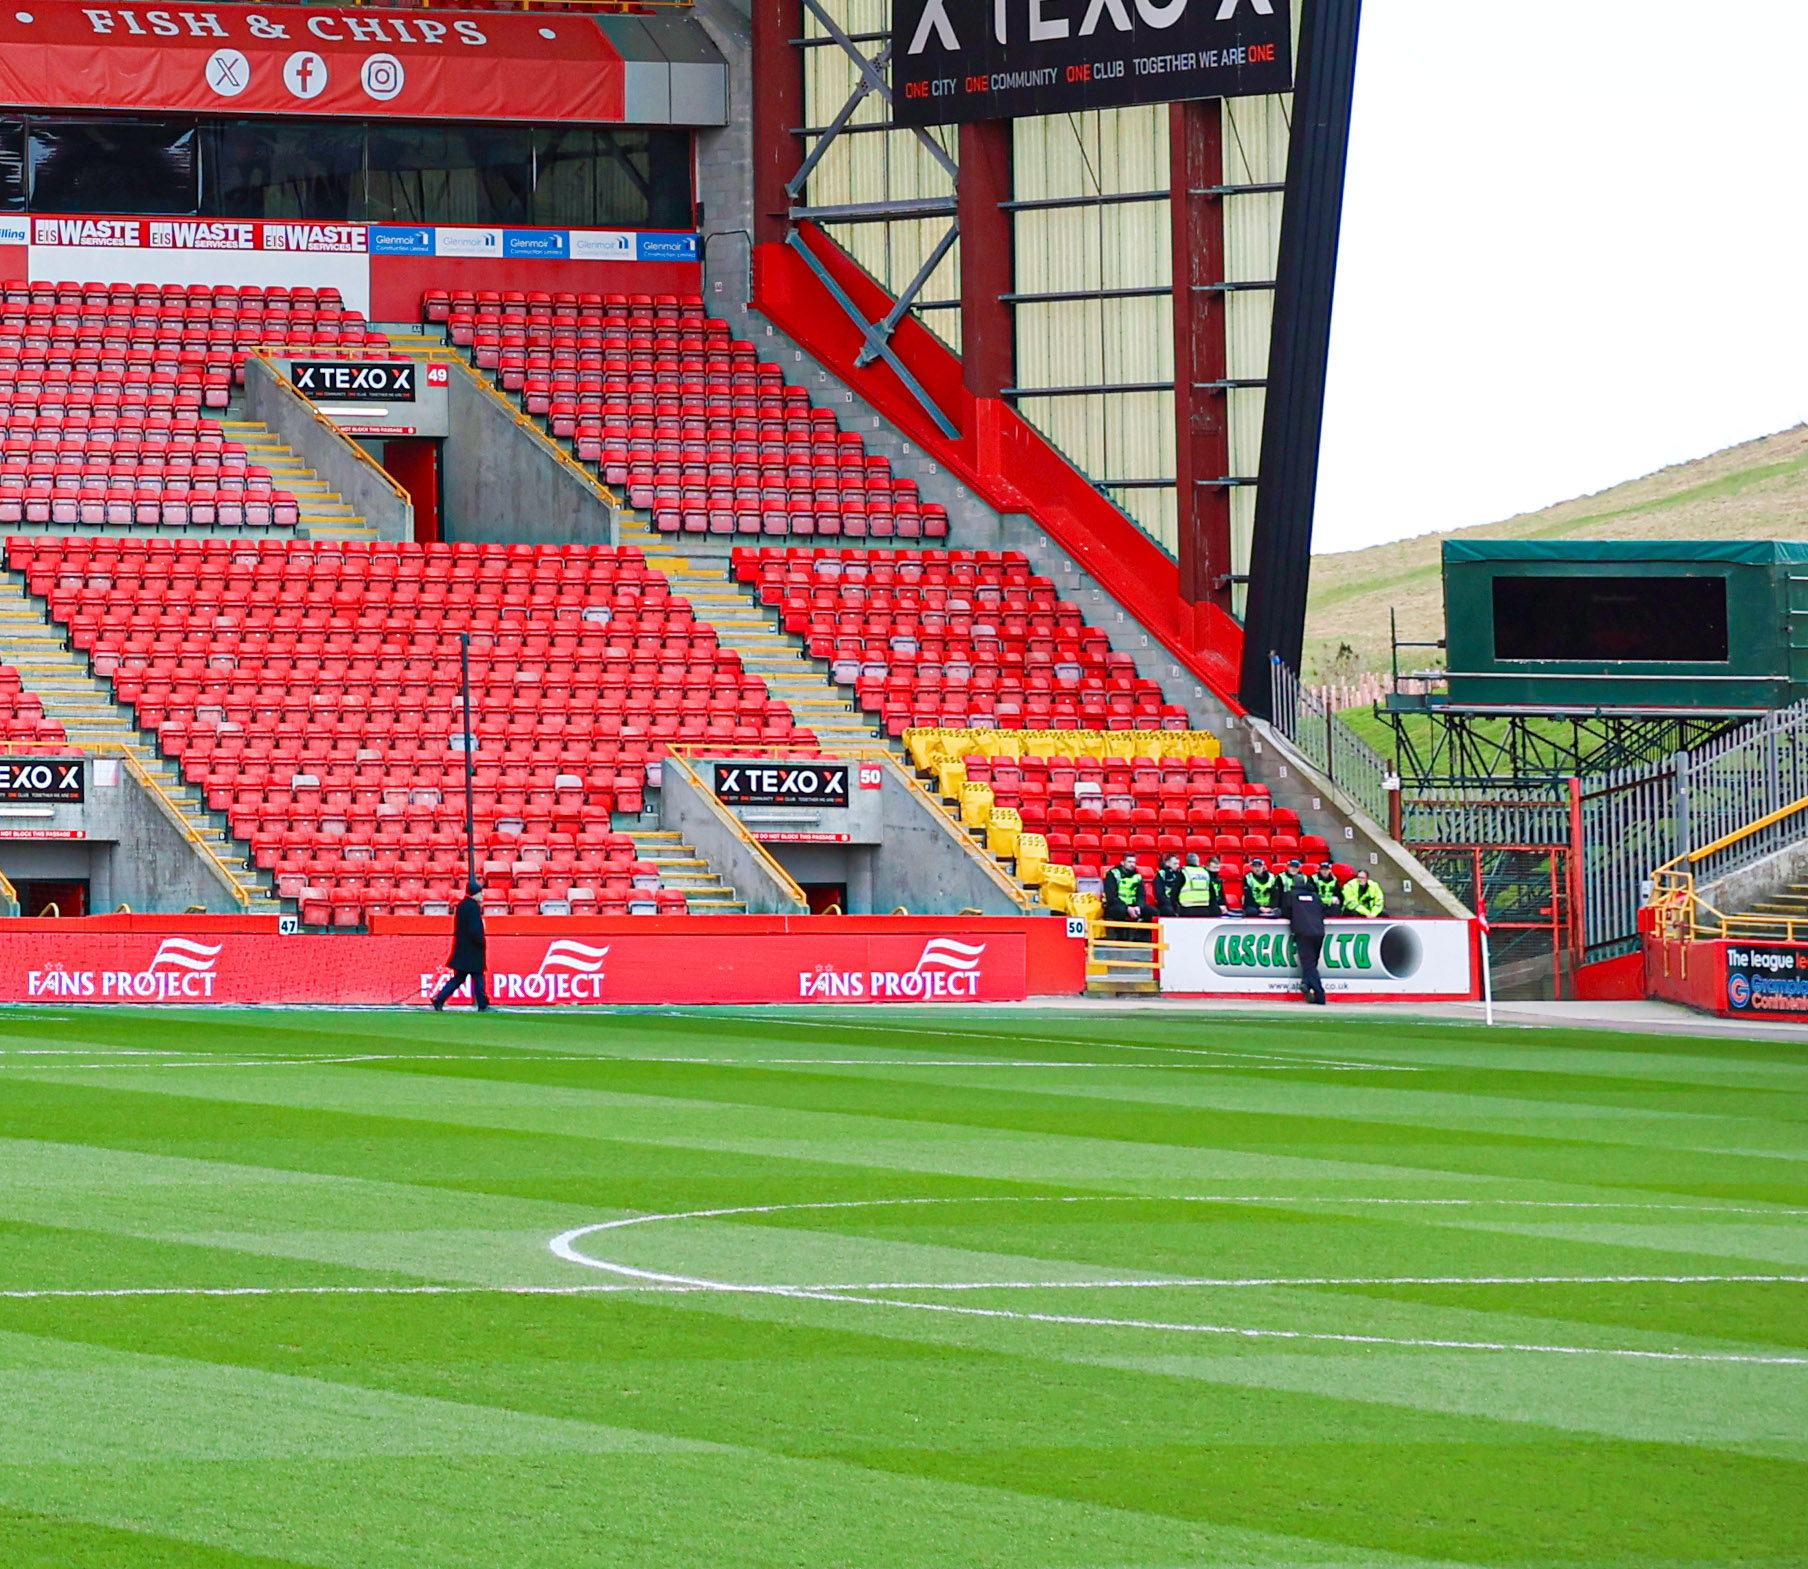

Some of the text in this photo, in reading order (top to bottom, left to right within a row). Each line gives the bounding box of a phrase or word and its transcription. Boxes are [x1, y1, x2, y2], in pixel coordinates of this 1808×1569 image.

[82, 9, 488, 46] FISH & CHIPS
[905, 44, 1274, 99] ONE CITY ONE COMMUNITY ONE CLUB TOGETHER WE ARE ONE
[37, 219, 140, 246] EIS WASTE
[80, 237, 123, 246] SERVICES
[152, 222, 254, 249] EIS WASTE
[195, 239, 238, 248] SERVICES
[265, 224, 367, 251] EIS WASTE
[308, 242, 351, 251] SERVICES
[296, 368, 410, 389] X TEXO X
[428, 368, 447, 382] 49
[58, 766, 79, 789] X
[719, 769, 844, 793] X TEXO X
[860, 770, 880, 783] 50
[281, 918, 298, 933] 47
[1069, 922, 1083, 933] 50
[1727, 950, 1748, 967] The
[1751, 950, 1794, 972] league
[29, 970, 218, 1001] FANS PROJECT
[493, 971, 605, 1002] PROJECT
[799, 970, 981, 999] FANS PROJECT
